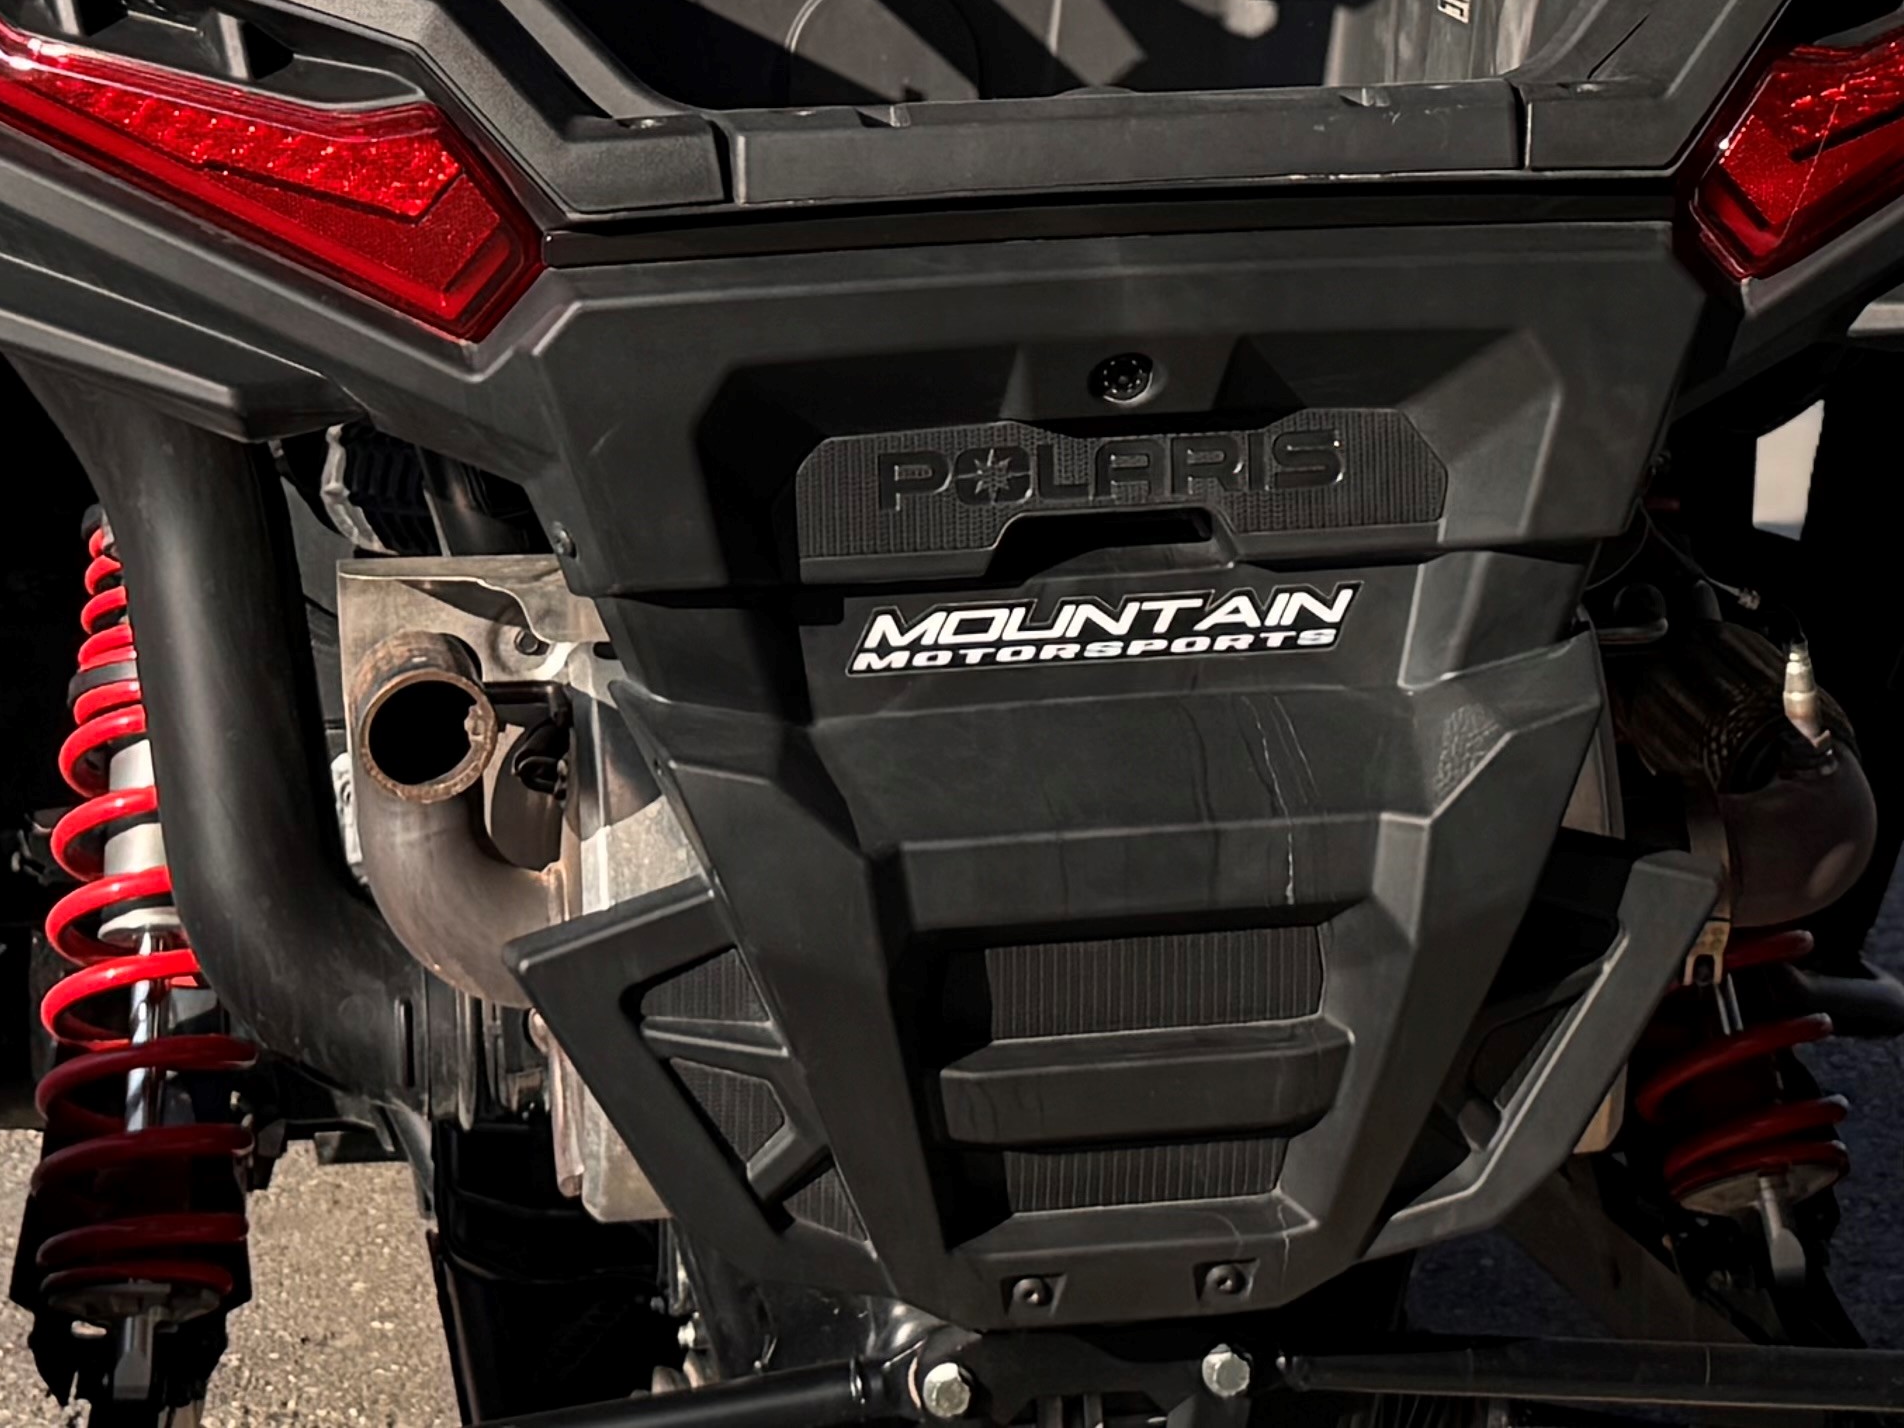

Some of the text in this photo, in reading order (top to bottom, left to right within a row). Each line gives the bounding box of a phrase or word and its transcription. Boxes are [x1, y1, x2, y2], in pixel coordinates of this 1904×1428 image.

[878, 429, 1345, 511] POLARIS
[851, 627, 1338, 671] MOTORSPORTS
[863, 588, 1354, 649] MOUNTAIN
